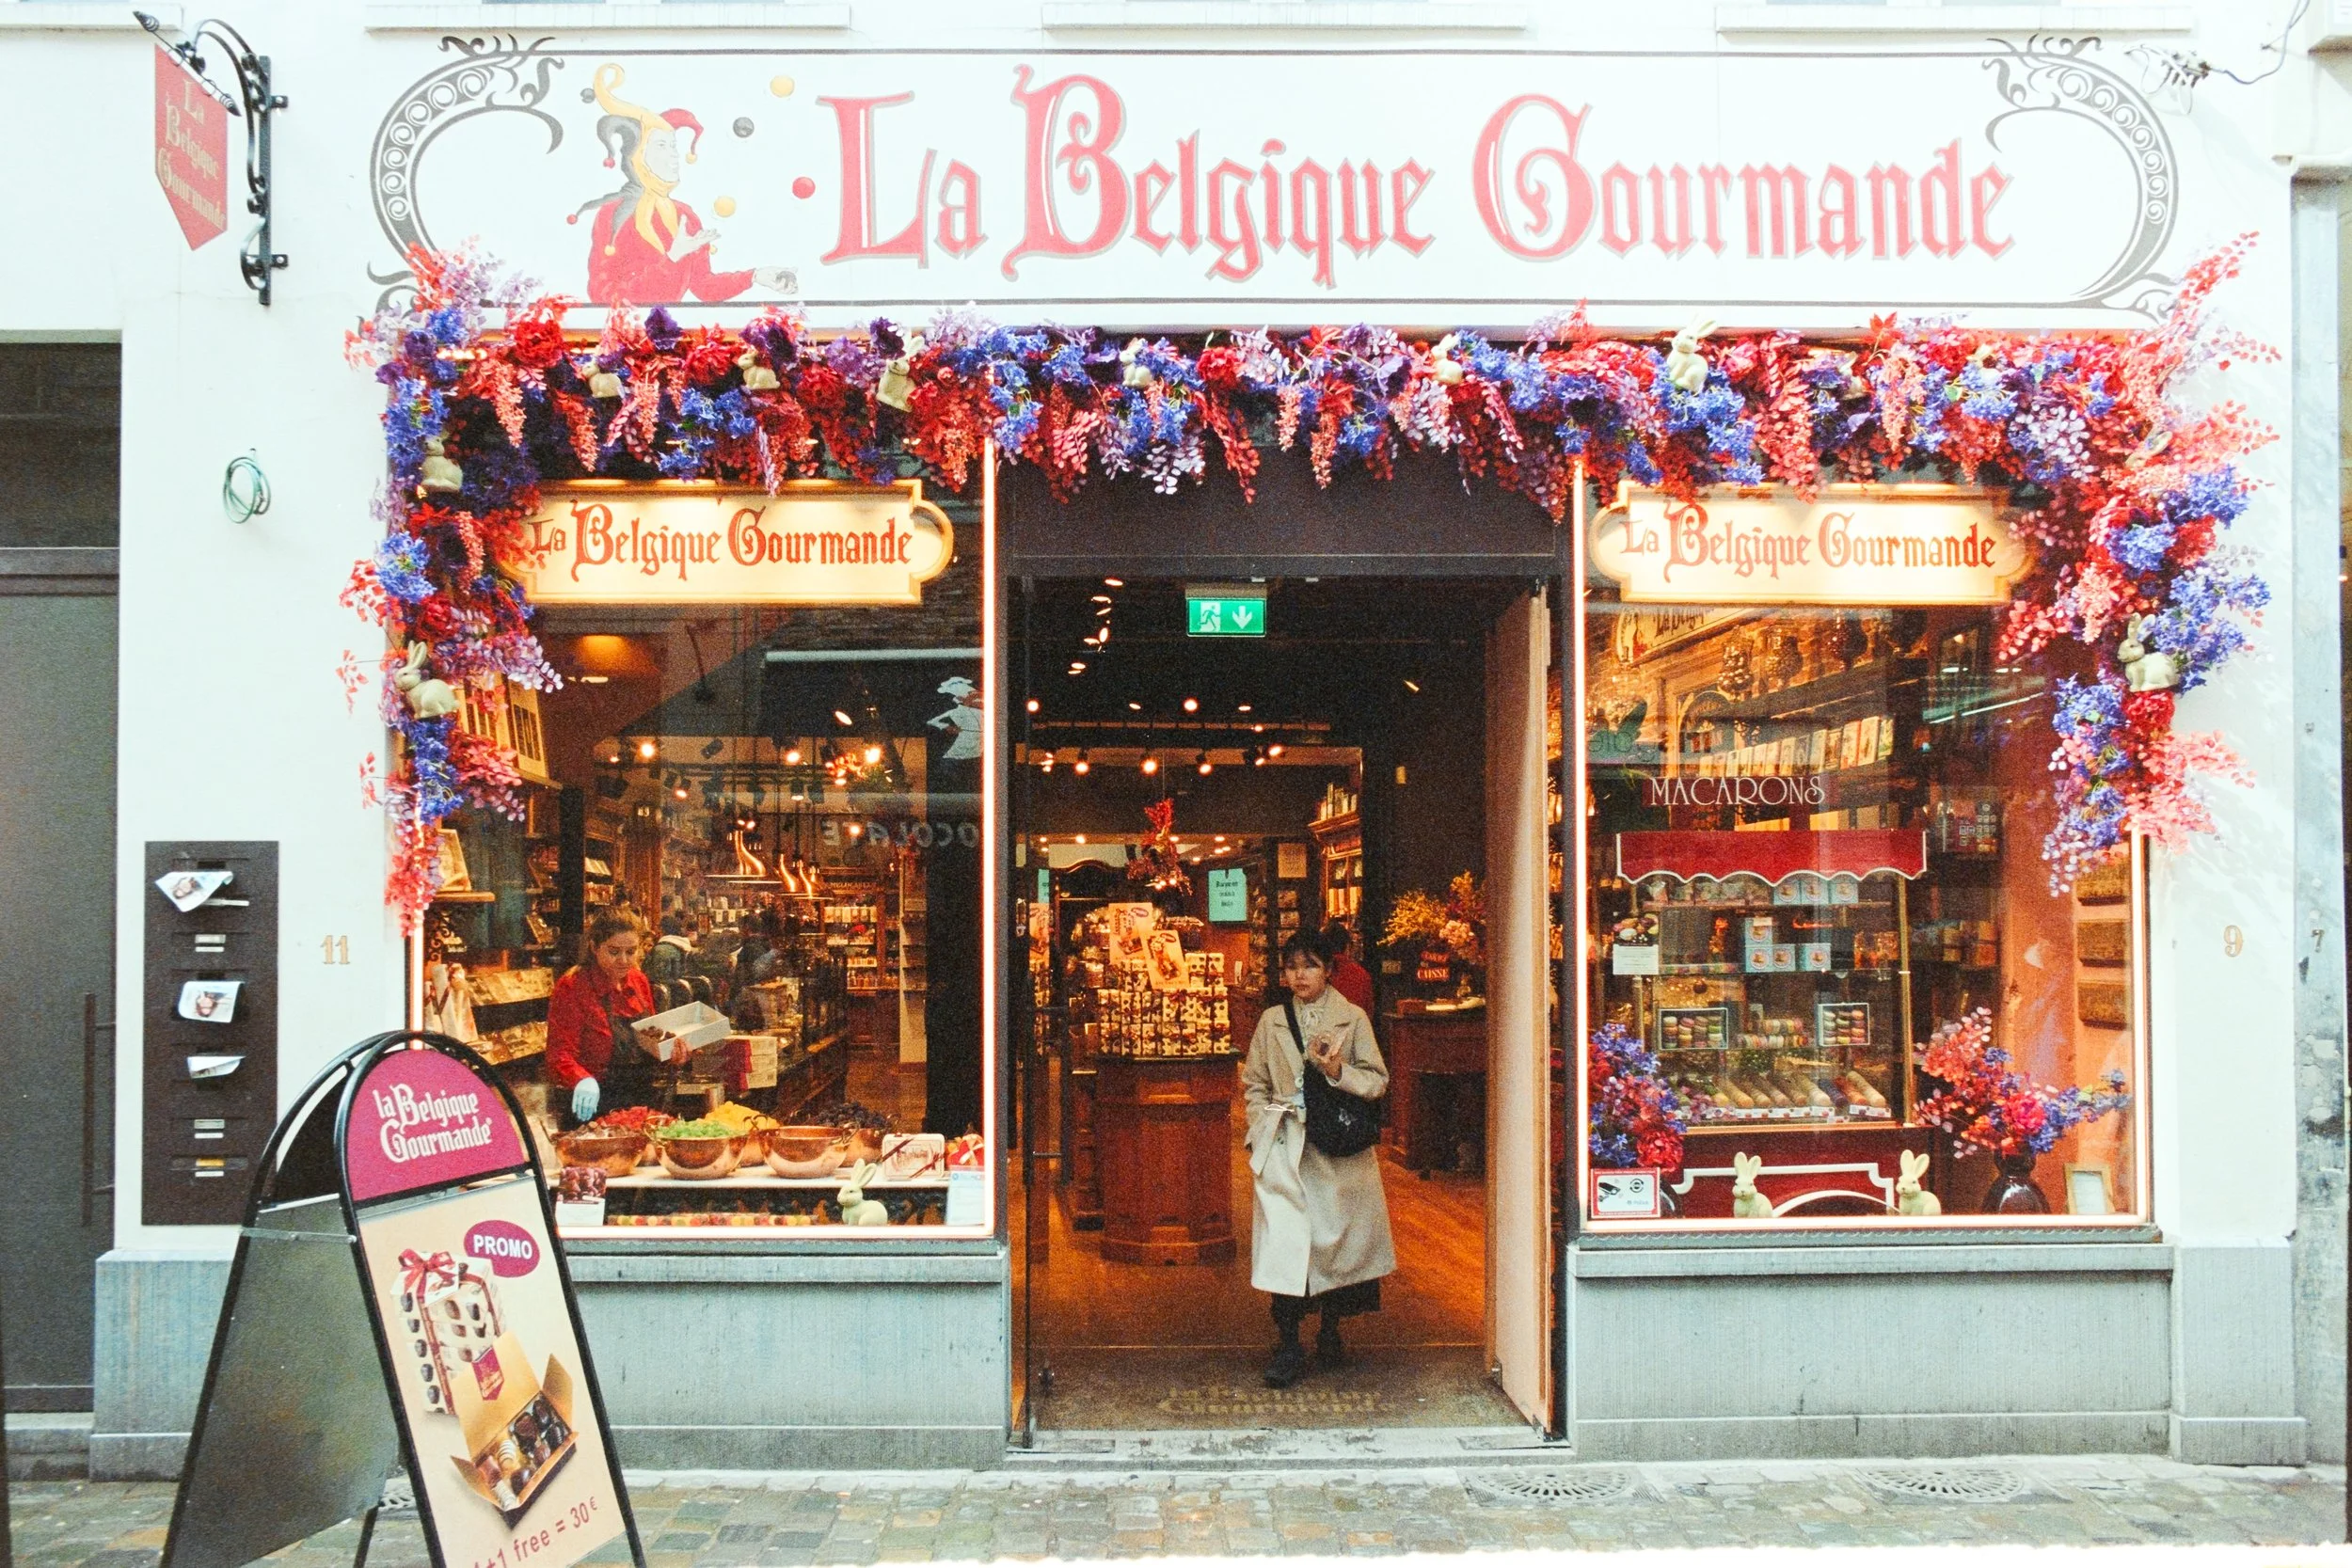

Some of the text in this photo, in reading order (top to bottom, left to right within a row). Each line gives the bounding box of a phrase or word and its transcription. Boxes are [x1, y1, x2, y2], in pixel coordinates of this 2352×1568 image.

[165, 91, 219, 181] Belgique
[157, 147, 227, 230] Gourmande
[816, 63, 2015, 290] La Belgique Gourmande
[529, 499, 914, 582] La Belgique Gourmande
[1620, 499, 1996, 583] La Belgique Gourmande
[1649, 776, 1825, 806] MACARONS
[320, 935, 350, 965] 11
[2223, 925, 2244, 957] 9
[2311, 928, 2325, 953] 7
[373, 1083, 479, 1134] la Belgique
[473, 1234, 532, 1260] PROMO
[514, 1529, 550, 1561] free
